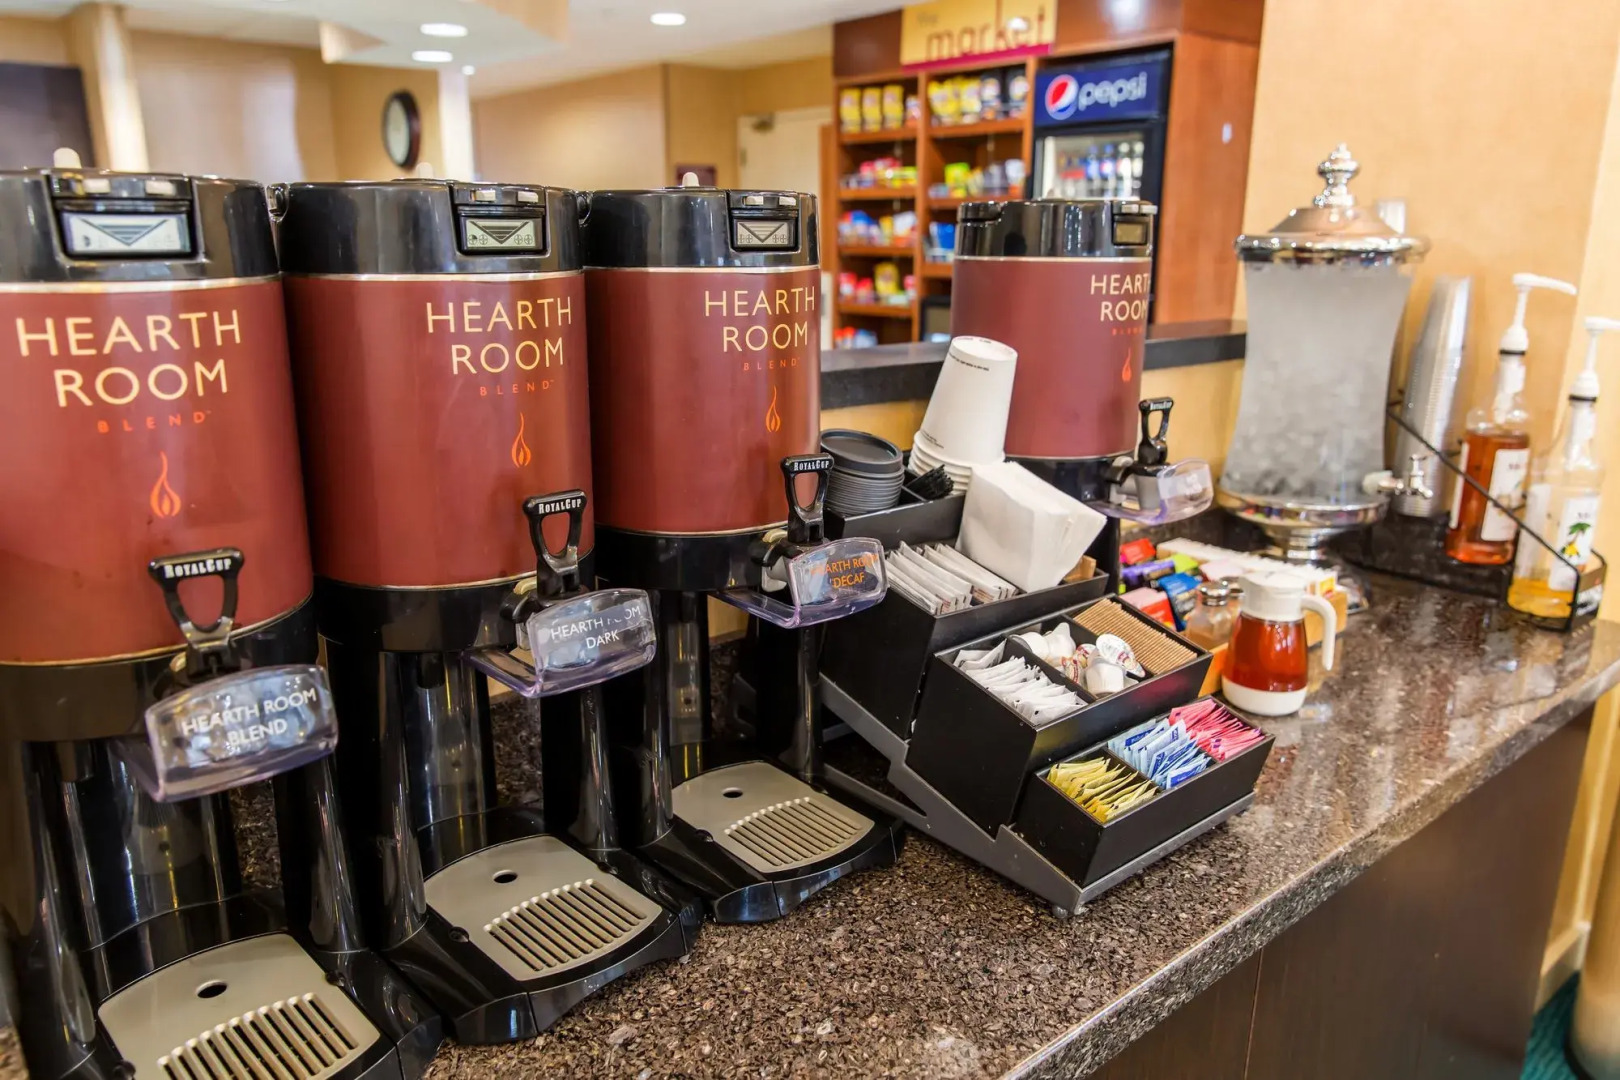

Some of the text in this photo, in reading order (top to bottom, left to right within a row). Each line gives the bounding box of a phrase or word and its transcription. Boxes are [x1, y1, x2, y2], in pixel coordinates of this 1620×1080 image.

[1078, 71, 1147, 111] pepsi
[1090, 273, 1151, 295] HEART
[426, 296, 572, 333] HEARTH
[704, 286, 815, 317] HEARTH
[16, 309, 241, 357] HEARTH
[723, 320, 808, 353] ROOM
[451, 337, 564, 375] ROOM
[743, 358, 797, 371] BLEND
[54, 358, 228, 407] ROOM
[479, 380, 550, 397] BLEND
[97, 410, 206, 433] BLEND
[811, 558, 851, 576] ARTH
[832, 572, 865, 589] DECAF
[551, 604, 641, 640] HEARTH OM
[586, 629, 620, 649] DARK
[181, 687, 317, 737] HEARTH ROOM
[226, 718, 289, 747] BLEND
